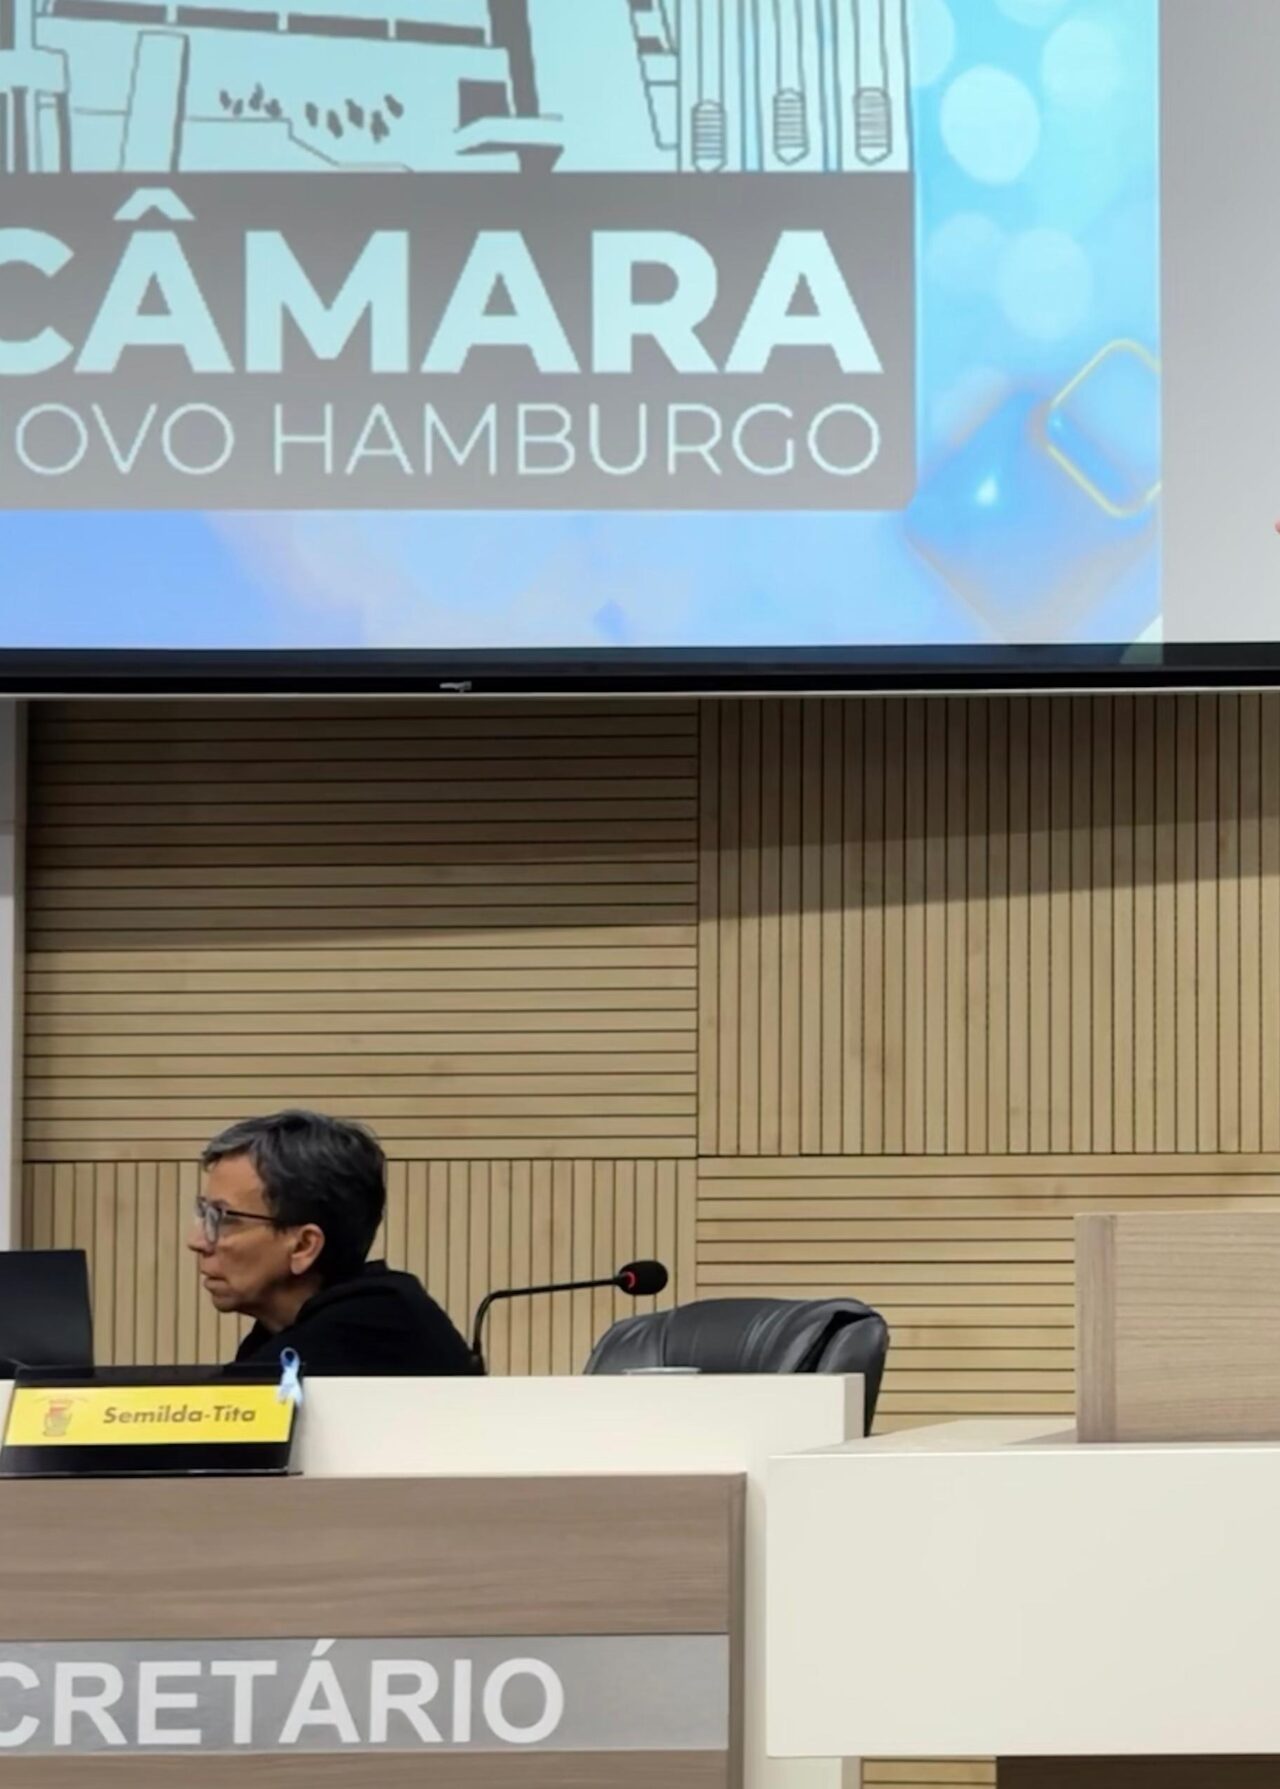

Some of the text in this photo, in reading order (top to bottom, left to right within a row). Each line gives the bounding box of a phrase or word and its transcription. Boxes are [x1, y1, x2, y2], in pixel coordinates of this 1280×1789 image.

[0, 187, 884, 375] CÂMARA
[273, 402, 881, 477] HAMBURGO
[103, 1405, 256, 1424] Semilda-Tita
